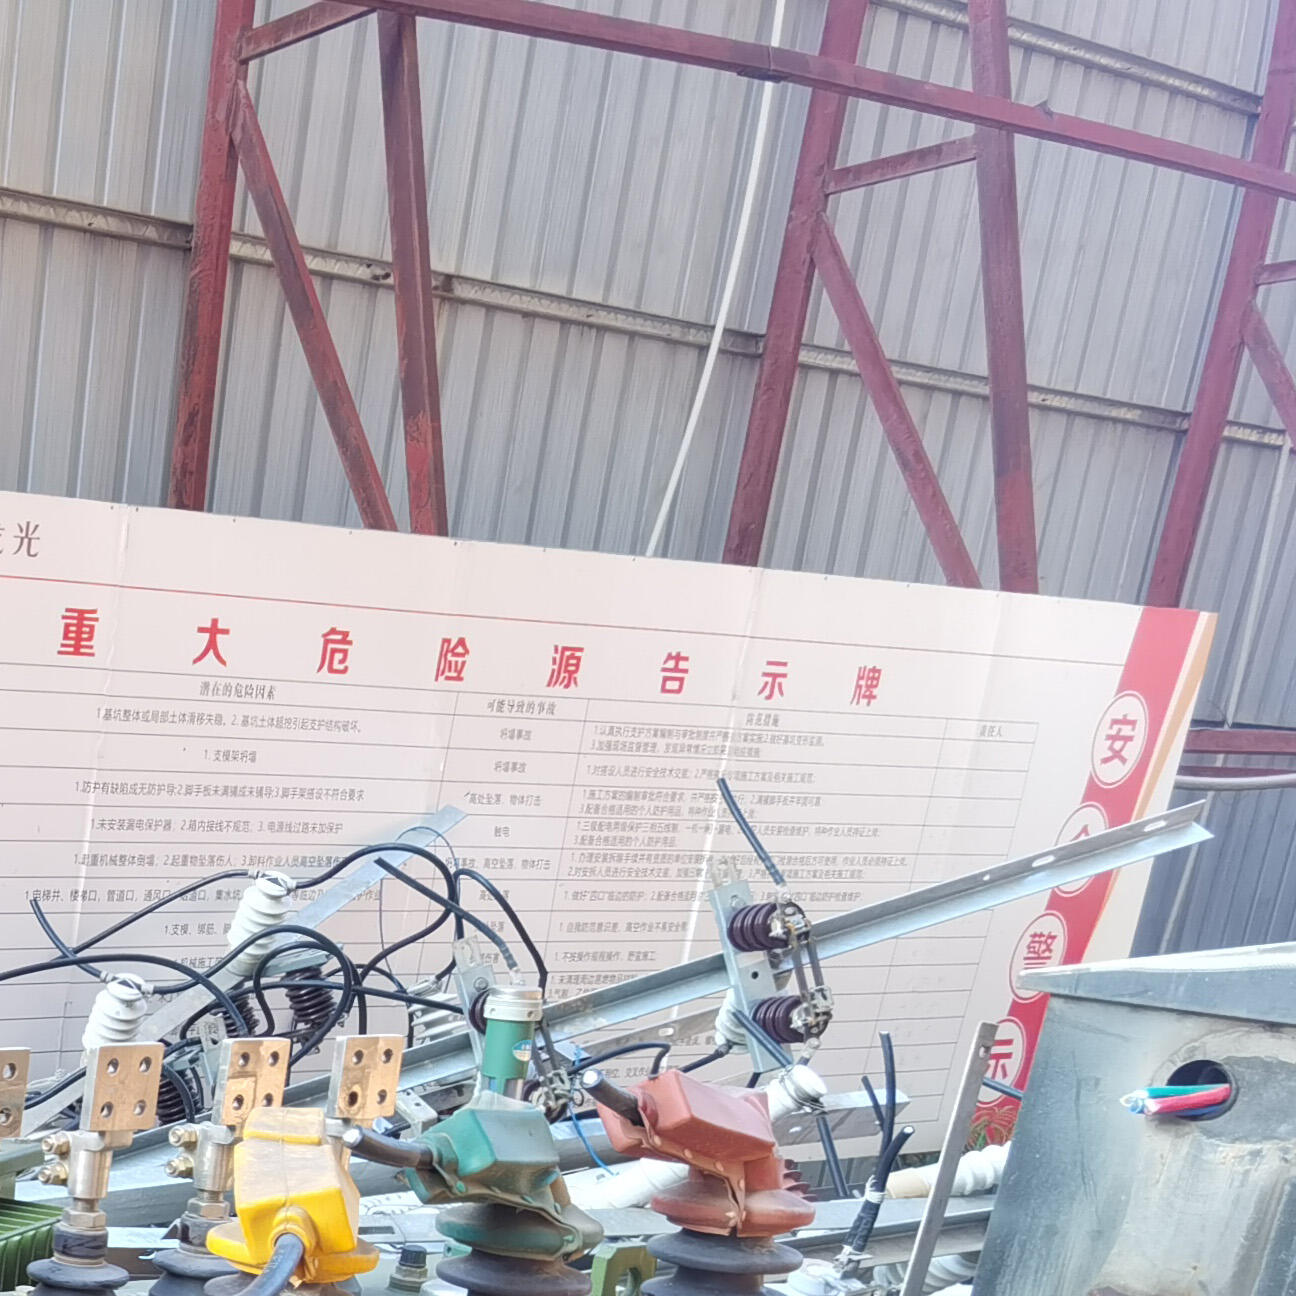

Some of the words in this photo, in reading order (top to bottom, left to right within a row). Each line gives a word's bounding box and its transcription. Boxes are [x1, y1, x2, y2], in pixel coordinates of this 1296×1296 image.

[57, 607, 884, 707] 重大危险源告示牌
[199, 680, 277, 701] 潜在的危险因素
[485, 698, 557, 716] 可能导致的事故
